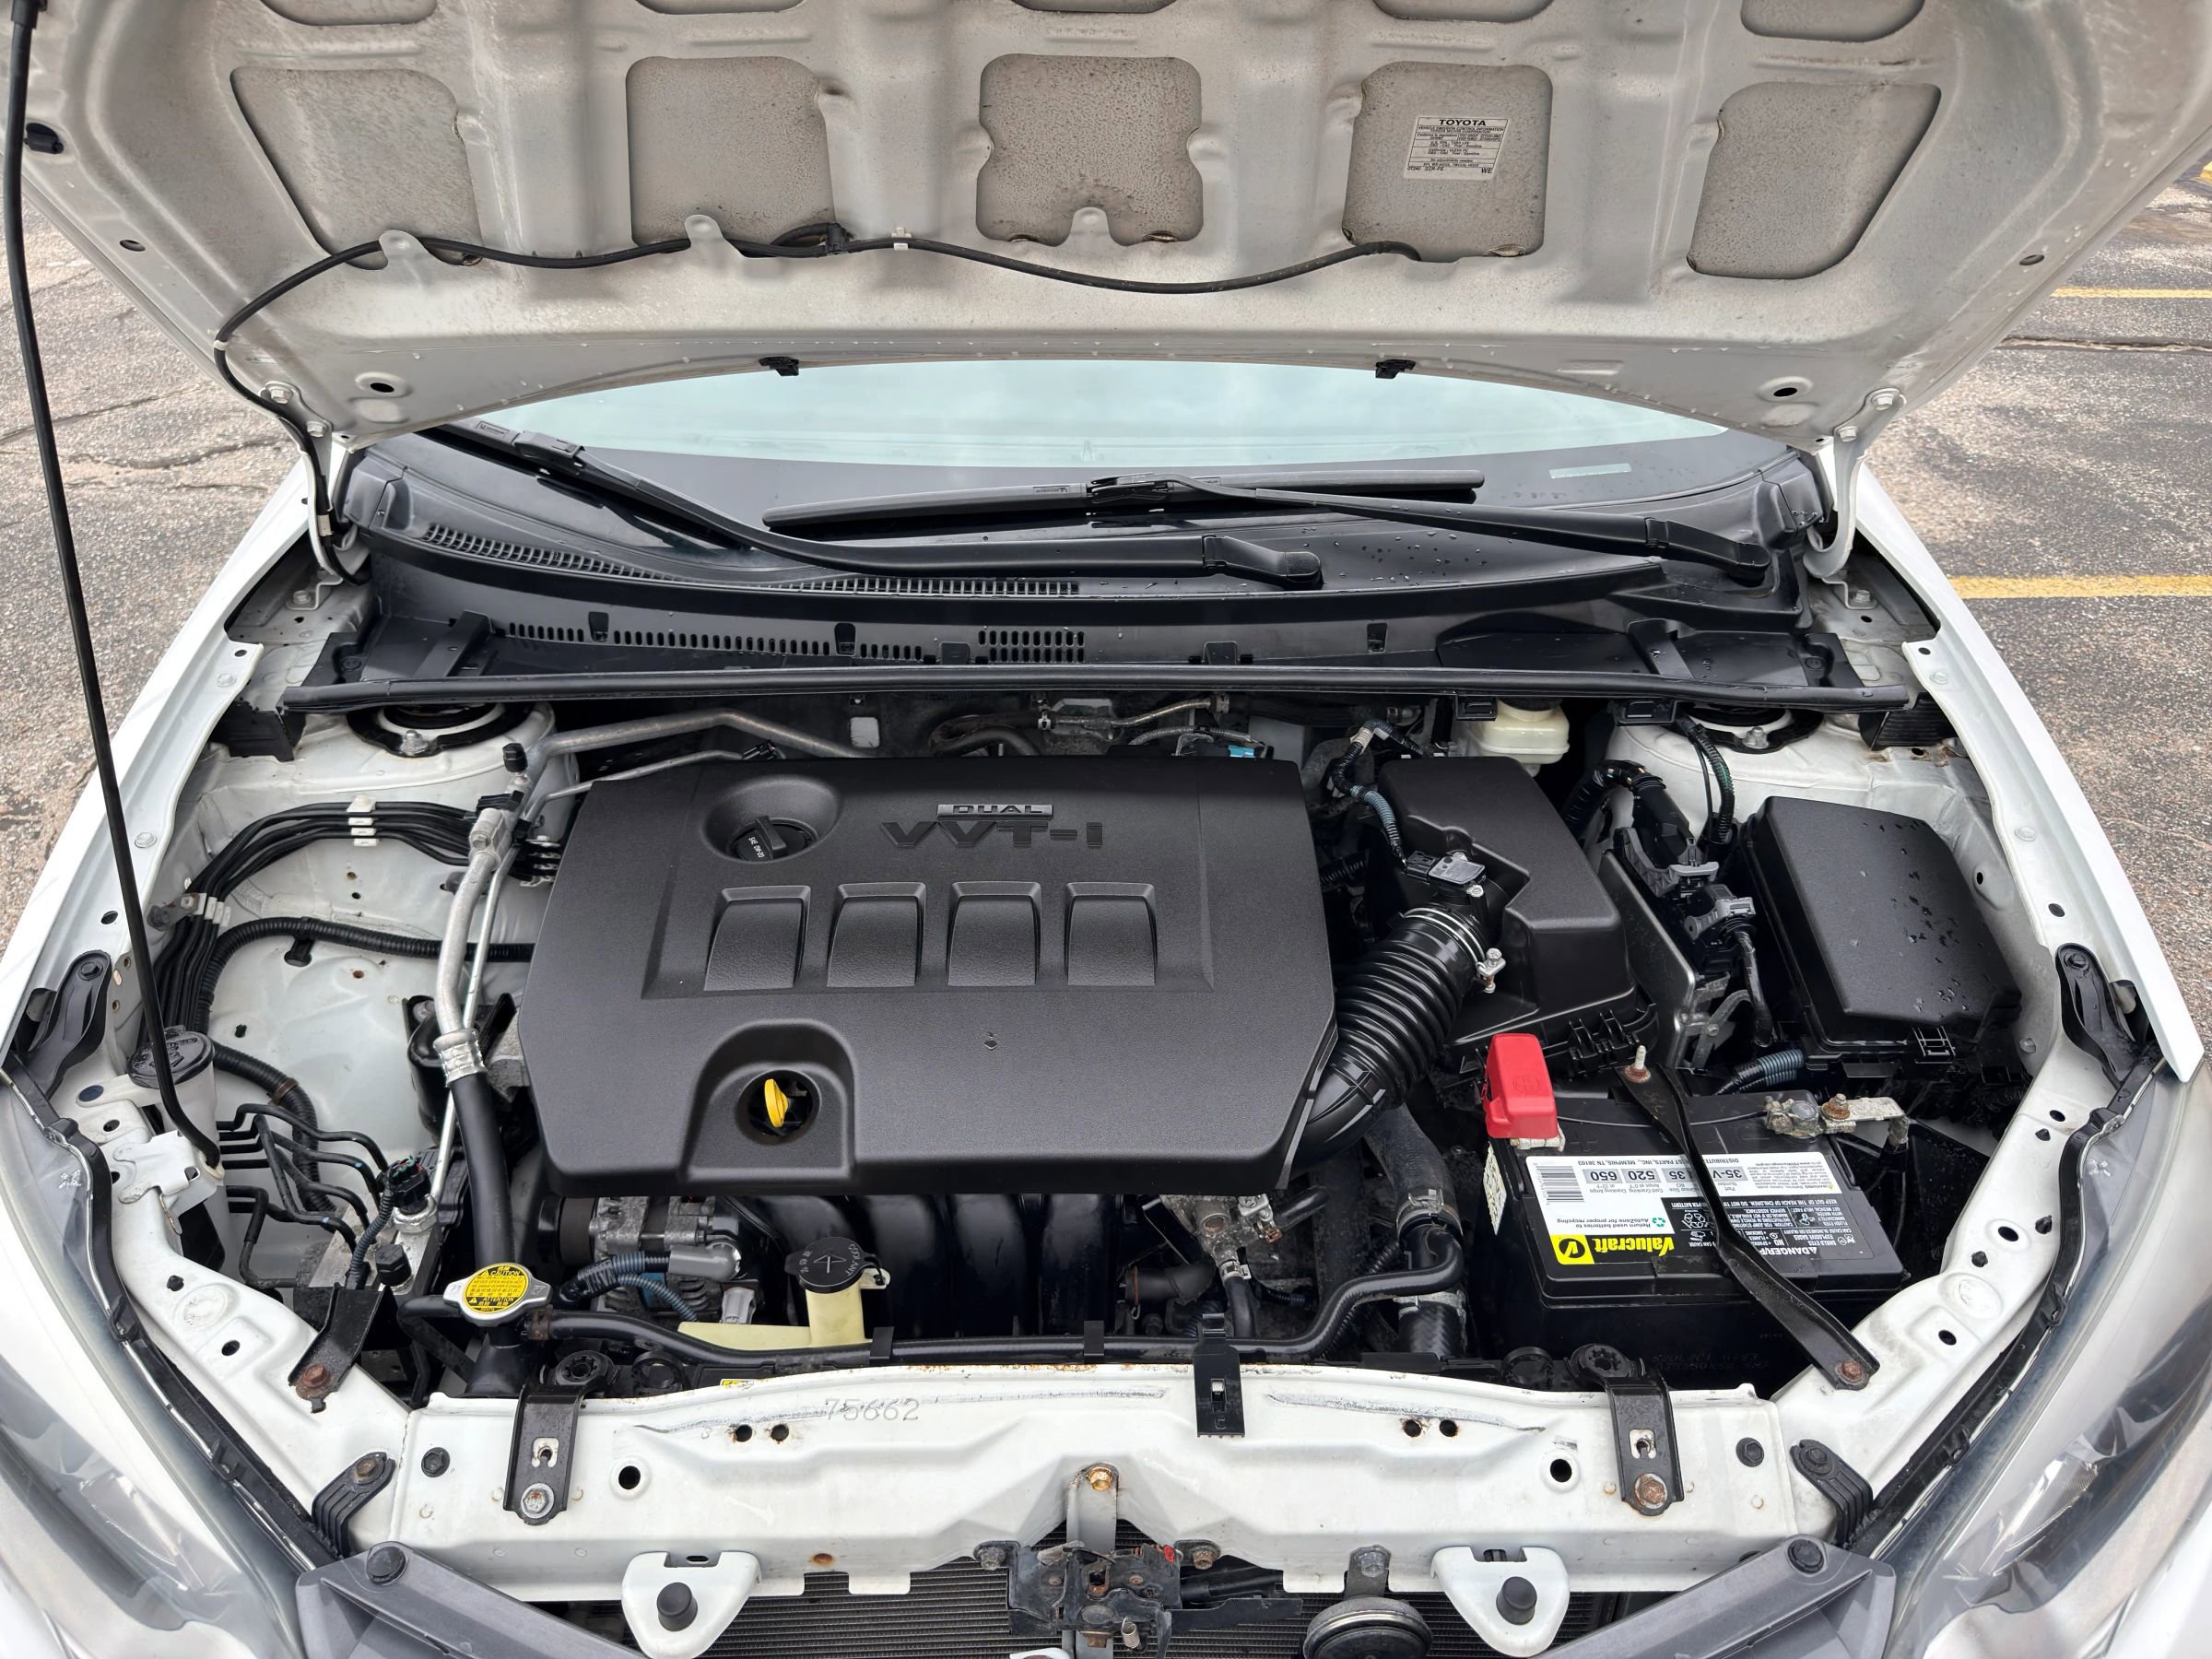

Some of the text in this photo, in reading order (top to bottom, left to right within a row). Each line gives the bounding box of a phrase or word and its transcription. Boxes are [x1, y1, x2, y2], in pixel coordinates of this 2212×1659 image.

[953, 805, 1043, 813] DUAL
[1591, 1171, 1618, 1181] 650
[1629, 1171, 1655, 1180] 520
[1669, 1171, 1685, 1180] 35
[1594, 1237, 1675, 1256] Valucraft
[826, 1398, 919, 1420] 75662
